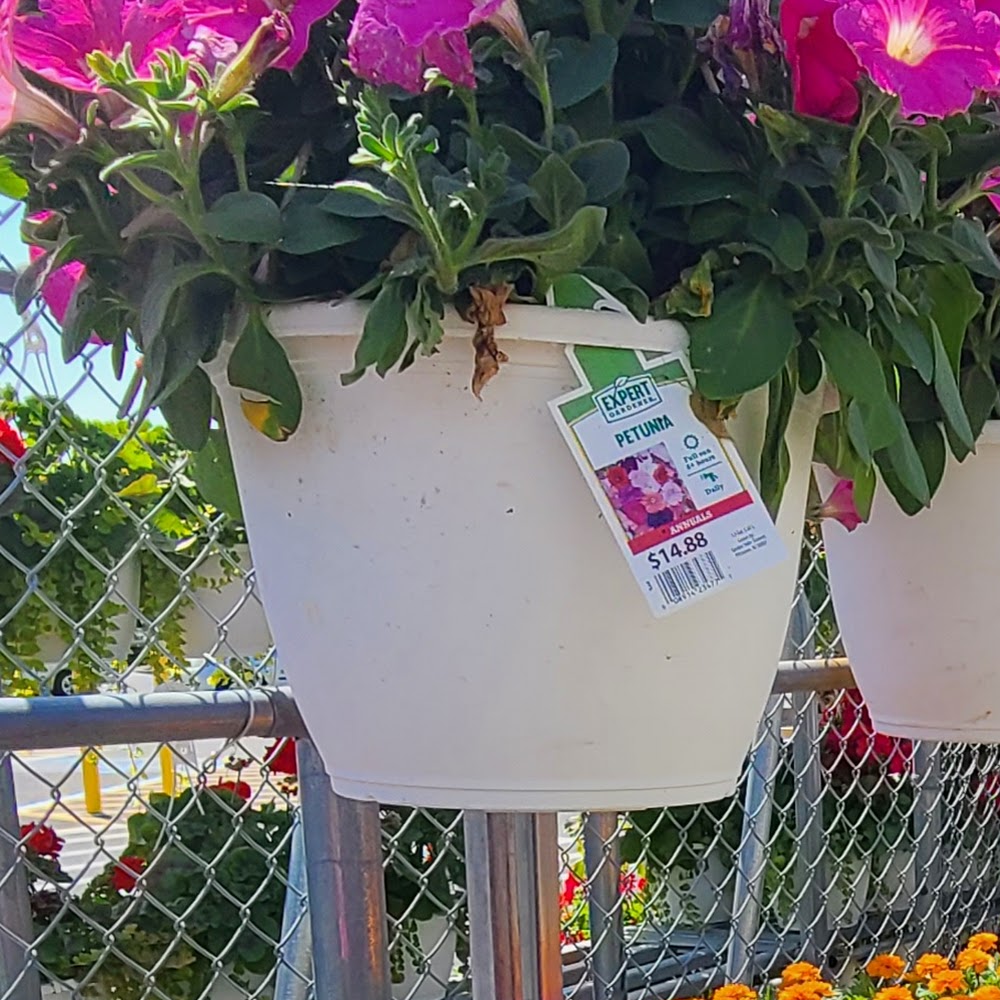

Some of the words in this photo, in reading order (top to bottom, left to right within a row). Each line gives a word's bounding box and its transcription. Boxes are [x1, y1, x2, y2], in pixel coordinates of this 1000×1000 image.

[601, 381, 651, 411] EXPERT
[609, 396, 656, 418] GARDENER
[615, 414, 674, 448] PETUNIA
[683, 452, 698, 463] Full
[696, 455, 715, 466] hours
[704, 484, 724, 495] Daily
[670, 510, 713, 535] ANNUALS
[648, 532, 708, 570] $14.88
